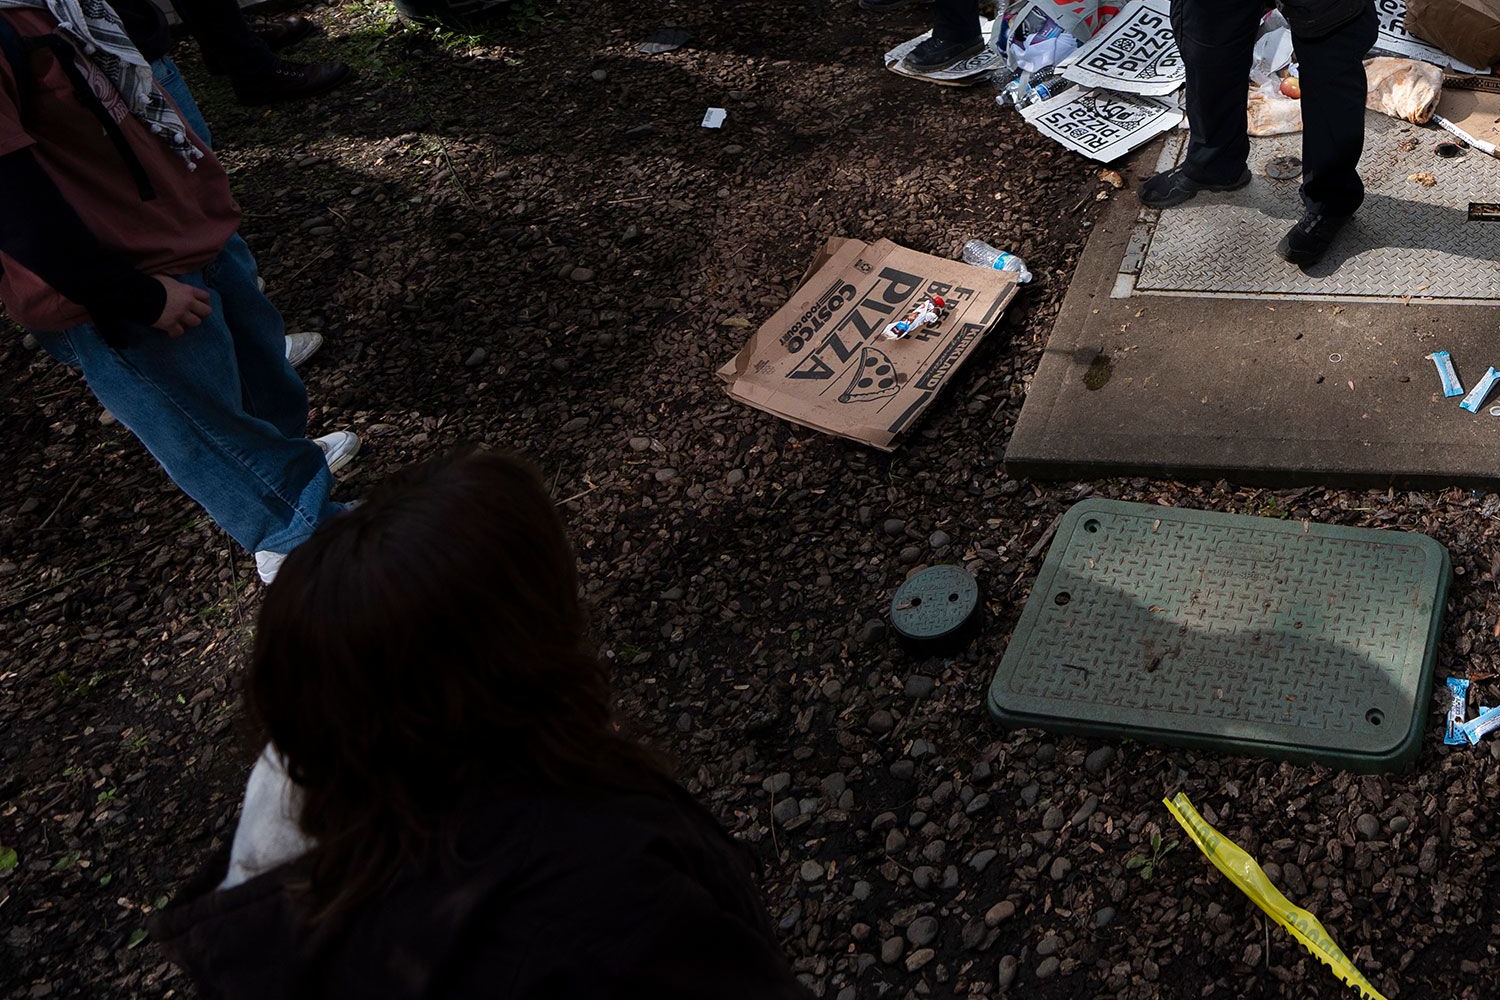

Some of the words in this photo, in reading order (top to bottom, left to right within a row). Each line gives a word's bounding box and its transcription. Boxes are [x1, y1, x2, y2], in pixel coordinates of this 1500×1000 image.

[779, 322, 802, 346] COURT
[788, 284, 857, 353] COSTCO
[788, 267, 924, 380] PIZZA
[800, 302, 820, 324] FOOD
[926, 327, 980, 388] KIRKLAND
